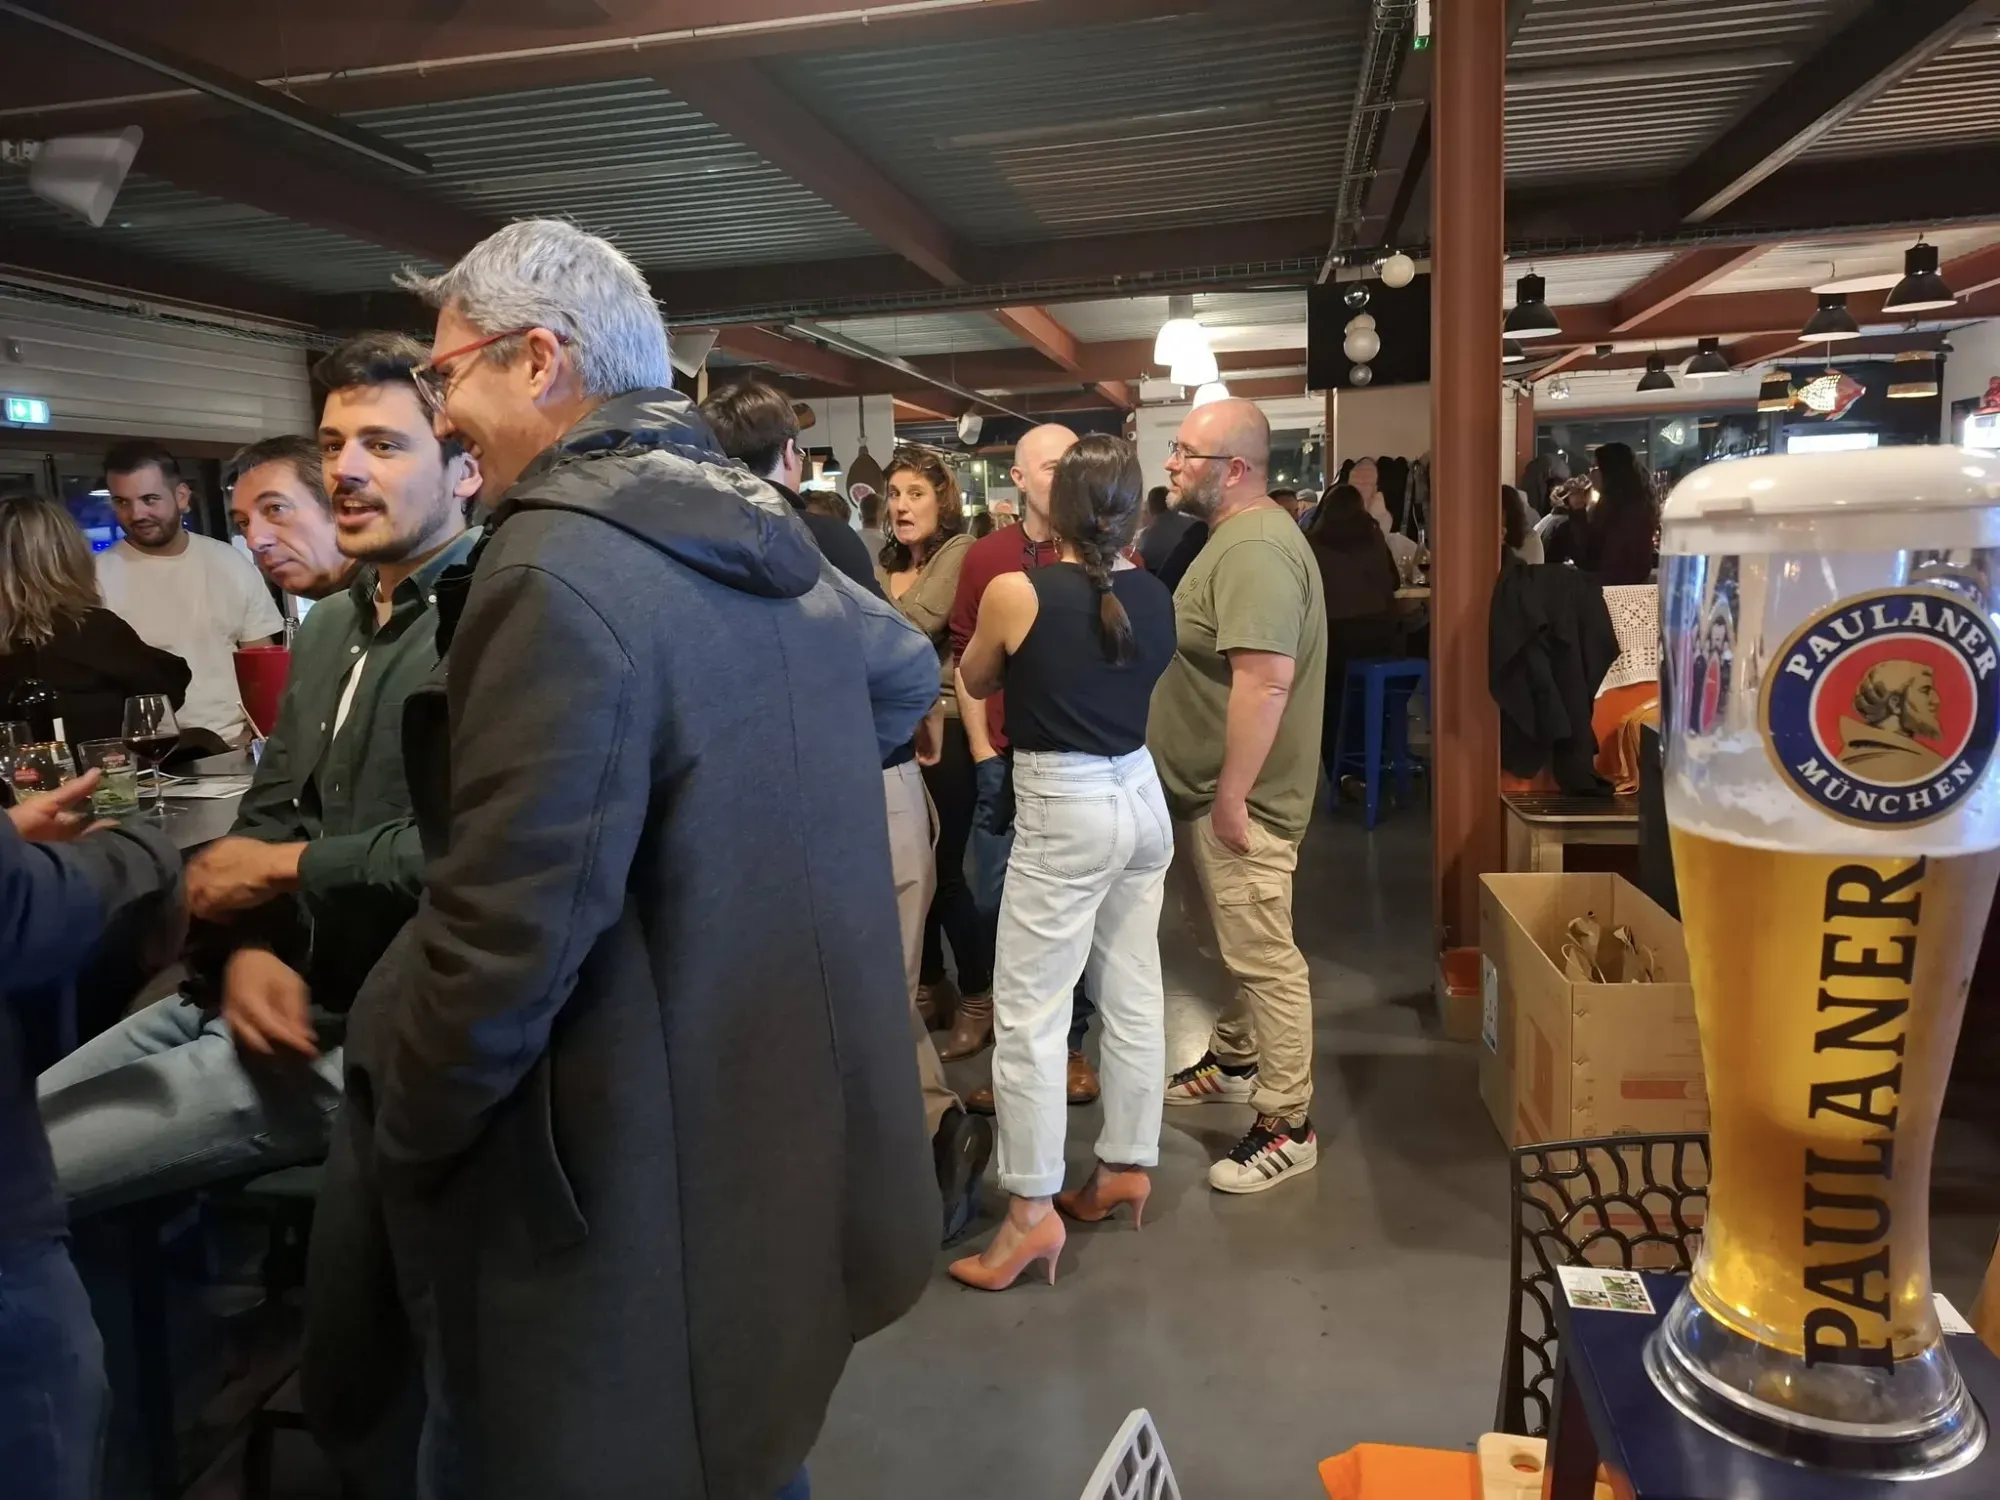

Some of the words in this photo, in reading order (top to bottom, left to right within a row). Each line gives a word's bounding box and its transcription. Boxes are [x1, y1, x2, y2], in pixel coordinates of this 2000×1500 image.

[1785, 601, 1998, 681] PAULANER
[1796, 757, 1975, 815] MÜNCHEN
[1803, 854, 1927, 1376] PAULANER
